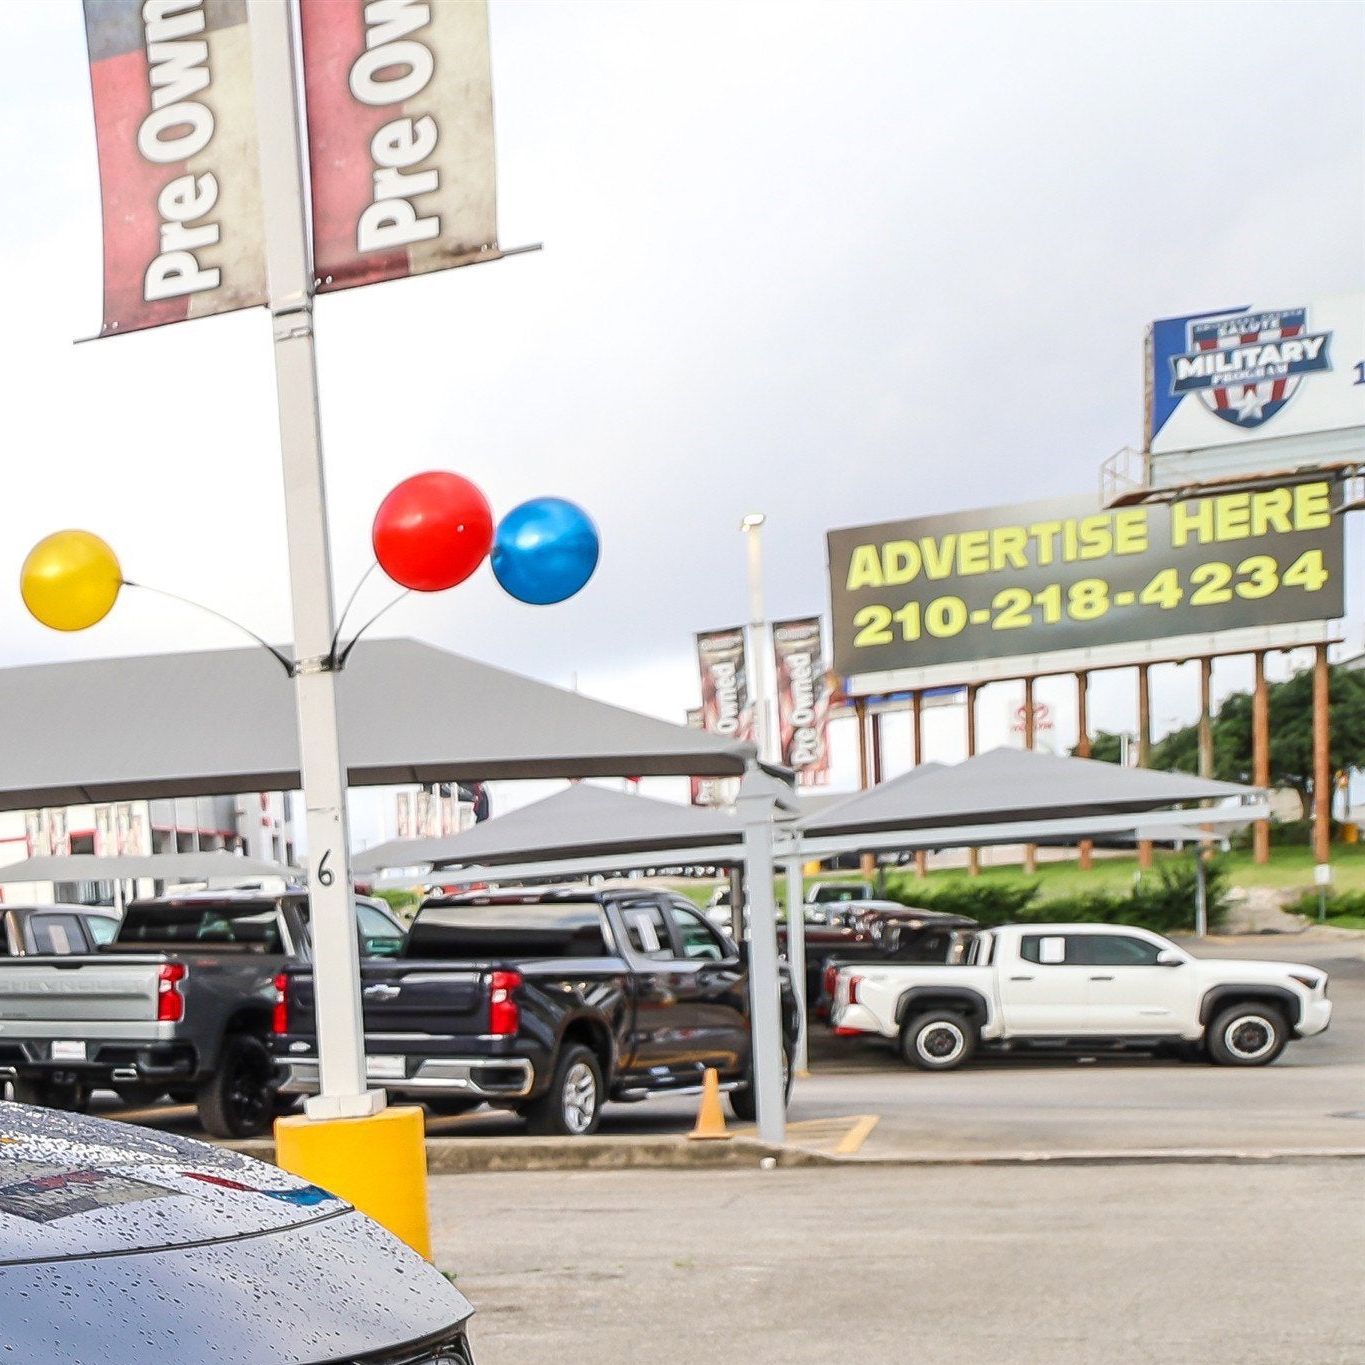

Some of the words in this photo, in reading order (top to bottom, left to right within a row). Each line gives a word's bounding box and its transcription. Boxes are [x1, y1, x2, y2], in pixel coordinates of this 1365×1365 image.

[143, 168, 220, 301] Pre
[357, 113, 440, 253] Pre
[1176, 335, 1326, 380] MILITARY
[846, 509, 1149, 591] ADVERTISE
[1172, 481, 1332, 548] HERE
[853, 549, 1329, 648] 210-218-4234
[318, 849, 334, 886] 6
